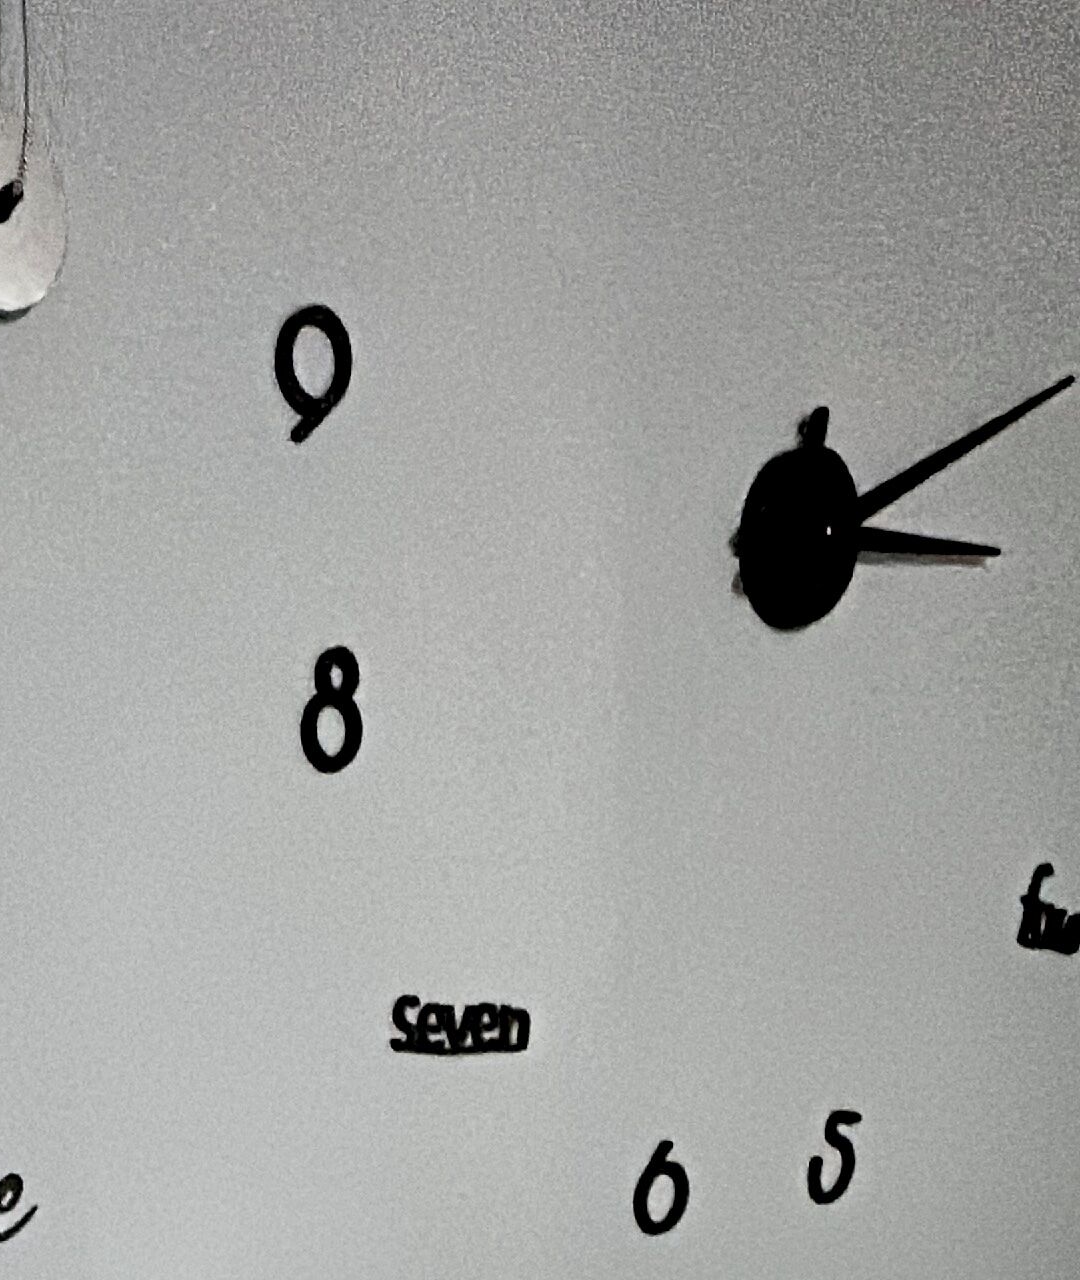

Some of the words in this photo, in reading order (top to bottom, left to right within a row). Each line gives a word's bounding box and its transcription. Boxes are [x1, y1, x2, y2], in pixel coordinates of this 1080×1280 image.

[274, 305, 352, 443] 9
[300, 646, 363, 773] 8
[633, 1140, 689, 1236] 6
[807, 1110, 862, 1205] 5
